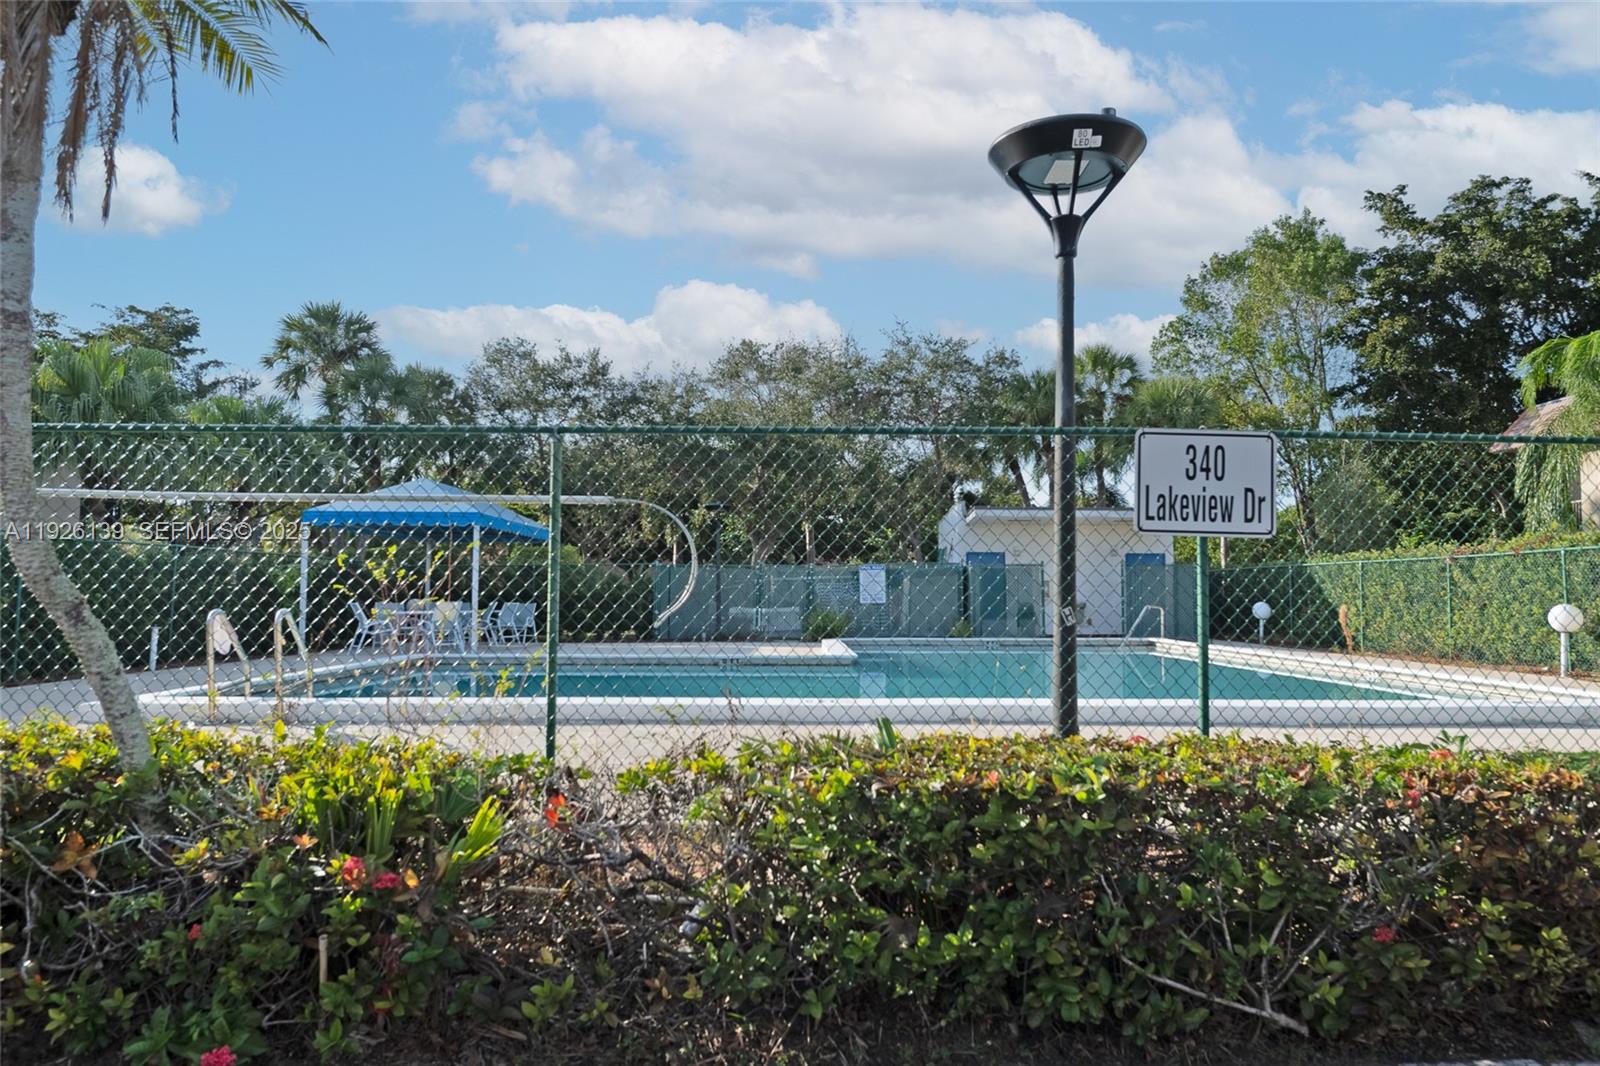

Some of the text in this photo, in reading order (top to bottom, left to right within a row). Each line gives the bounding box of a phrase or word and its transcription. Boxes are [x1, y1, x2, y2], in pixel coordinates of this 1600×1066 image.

[1074, 138, 1090, 146] LED
[1185, 444, 1226, 481] 340
[1145, 485, 1266, 524] Lakeview Dr
